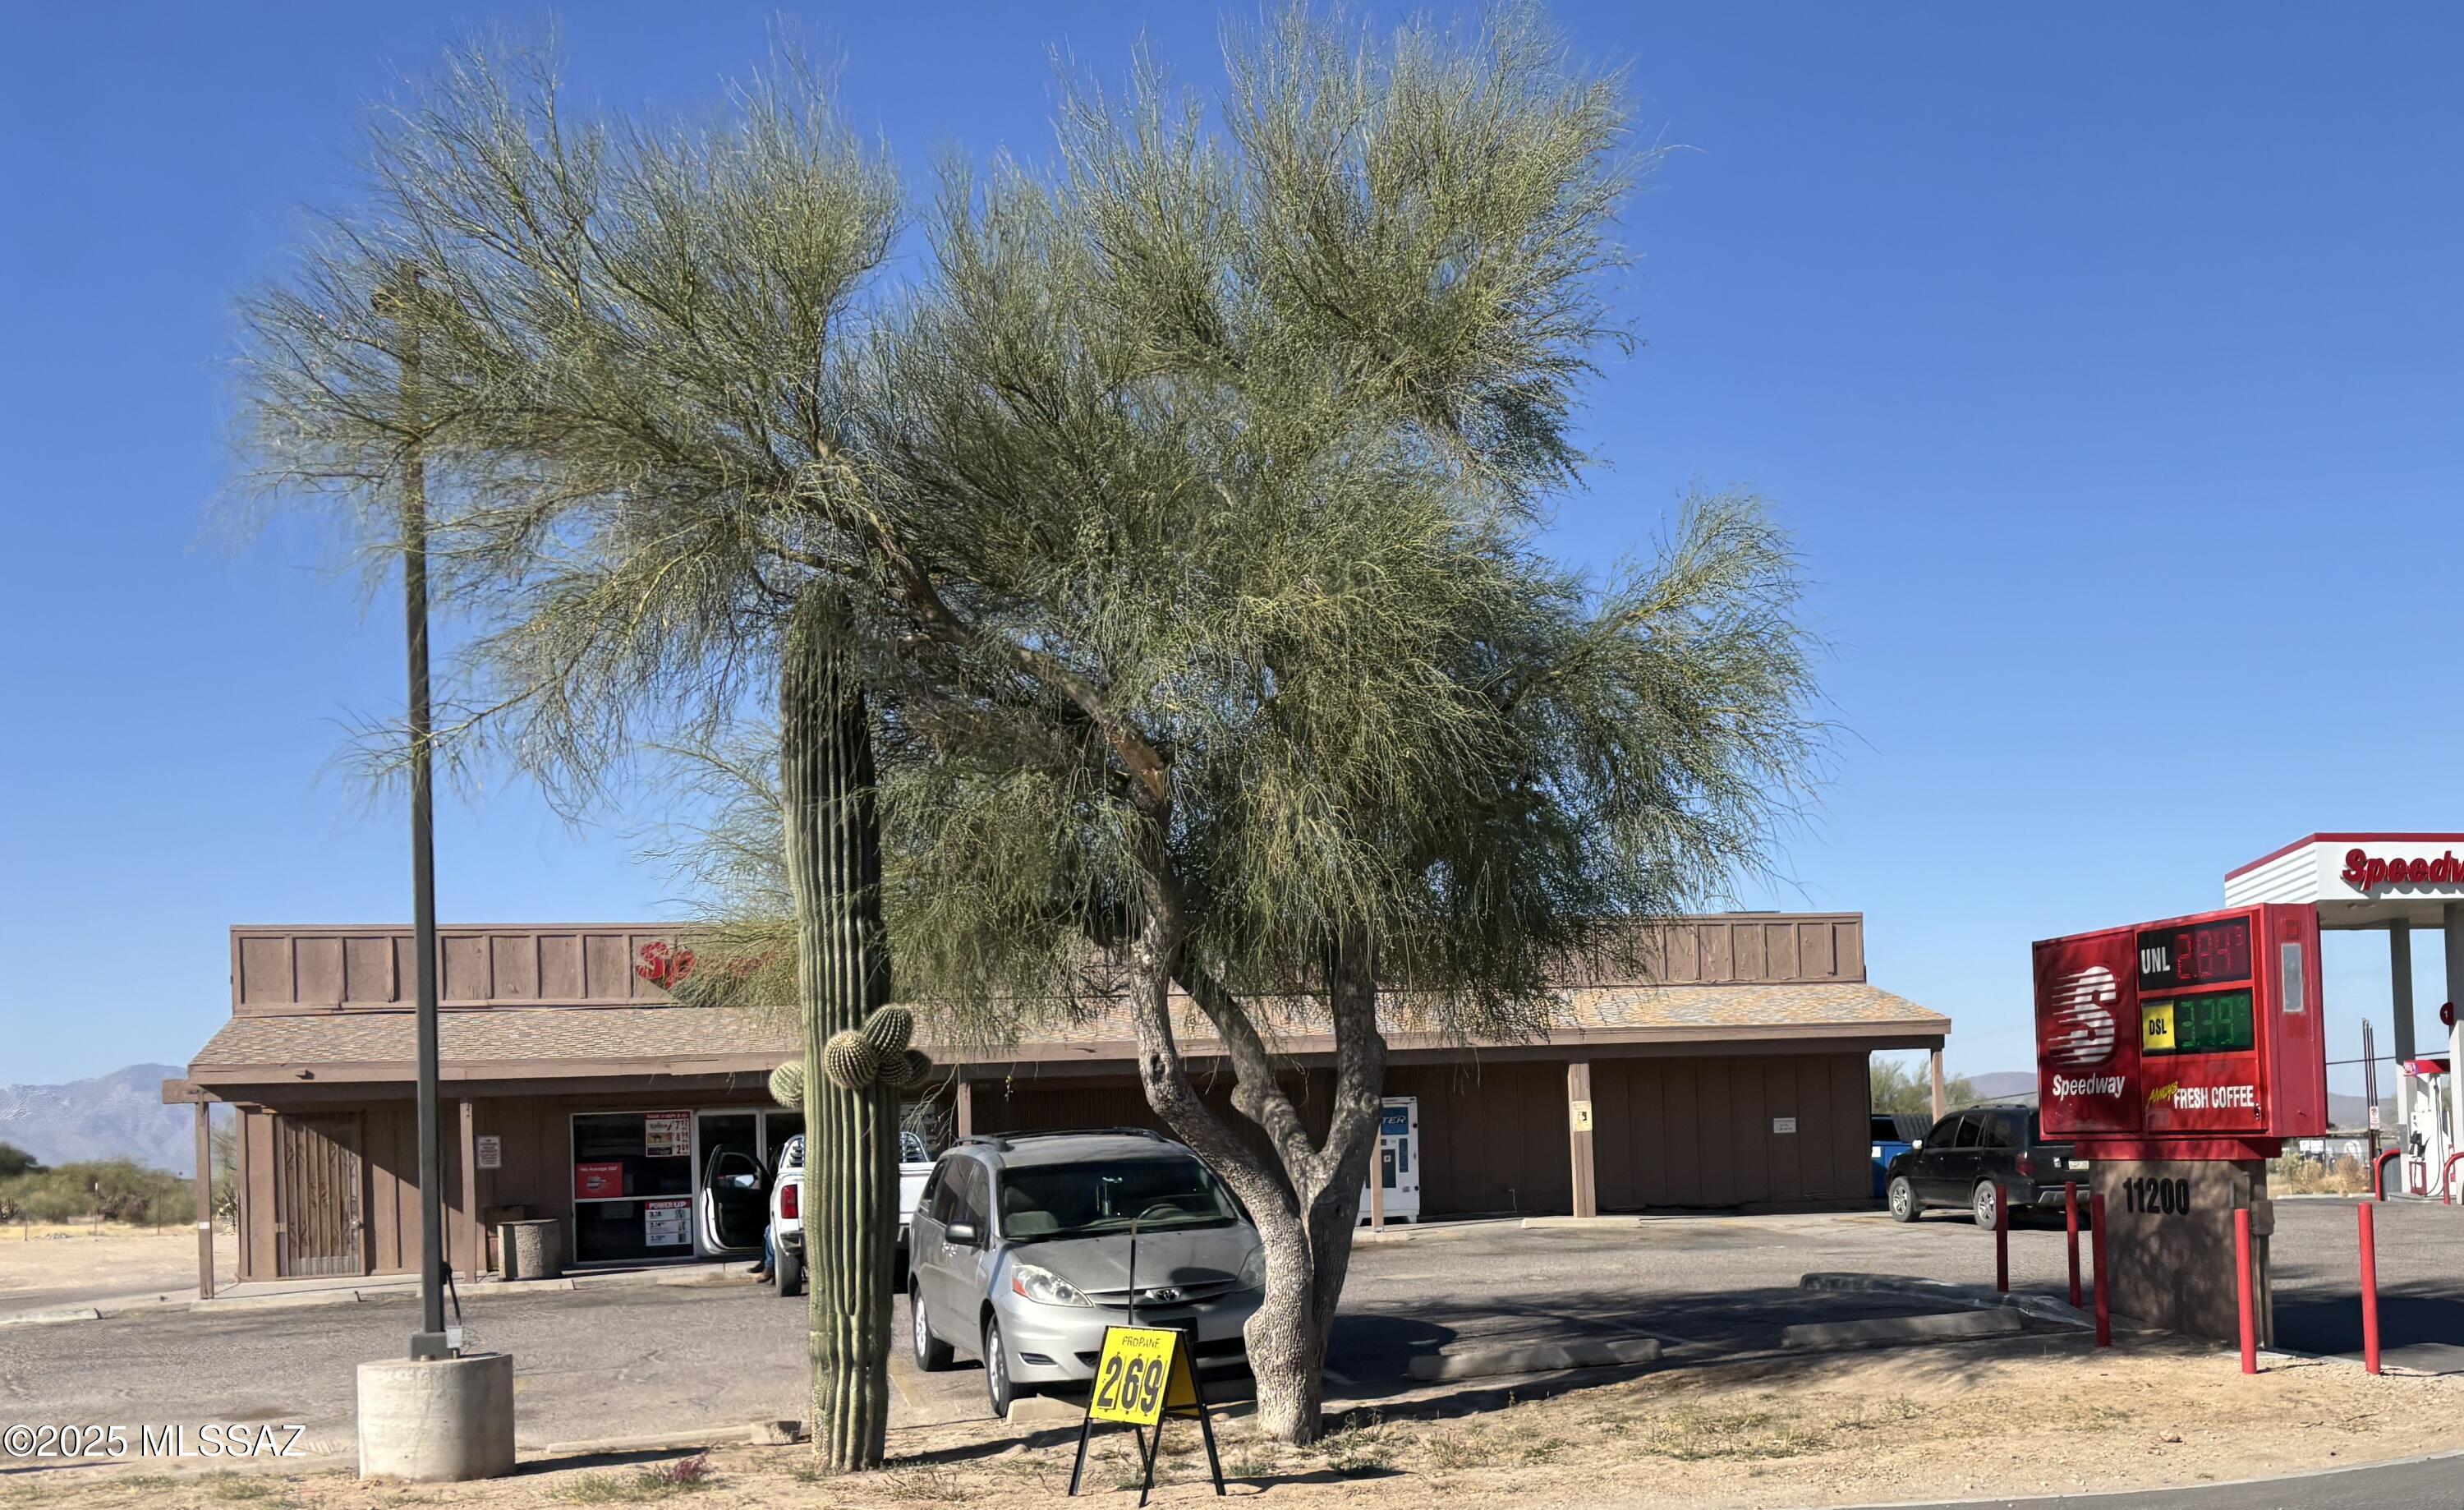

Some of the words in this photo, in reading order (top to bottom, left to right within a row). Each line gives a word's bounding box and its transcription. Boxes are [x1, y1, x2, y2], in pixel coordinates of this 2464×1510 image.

[2141, 946, 2171, 974] UNL
[2149, 1018, 2167, 1035] DSL
[2053, 1073, 2126, 1102] Speedway
[2173, 1087, 2209, 1109] FRESH
[2211, 1085, 2255, 1108] COFFEE
[1381, 1115, 1407, 1124] TER
[2122, 1176, 2190, 1215] 11200
[1121, 1336, 1160, 1349] PROPANE
[1096, 1356, 1163, 1413] 269
